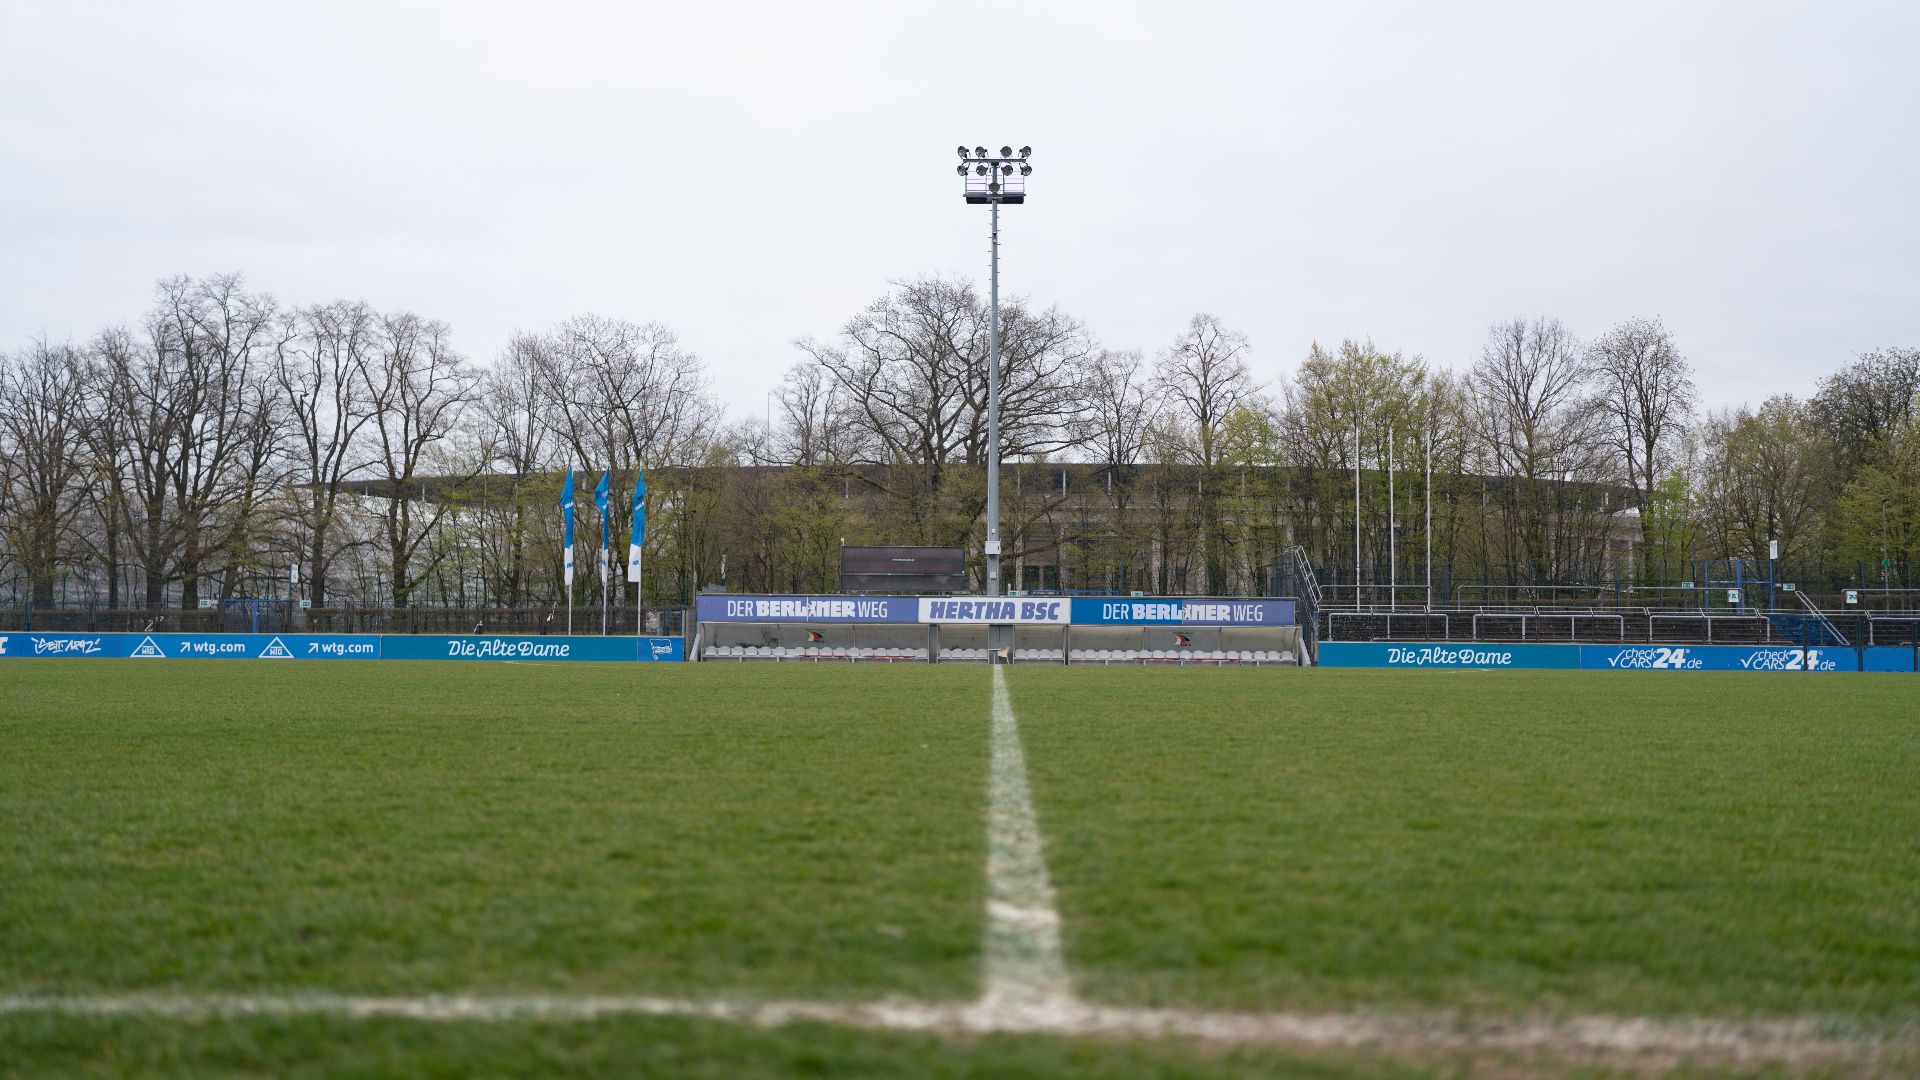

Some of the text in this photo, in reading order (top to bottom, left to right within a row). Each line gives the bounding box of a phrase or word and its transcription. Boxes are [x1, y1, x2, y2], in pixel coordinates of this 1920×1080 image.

[727, 601, 753, 617] DER
[858, 601, 888, 618] WEG
[930, 601, 1060, 620] HERTHA BSC
[1103, 603, 1129, 619] DER
[1233, 604, 1263, 622] WEG
[194, 642, 245, 654] wtg.com
[322, 642, 373, 654] wtg.com
[448, 640, 569, 657] Die Alte Dame
[1388, 647, 1511, 665] Die Alte Dame
